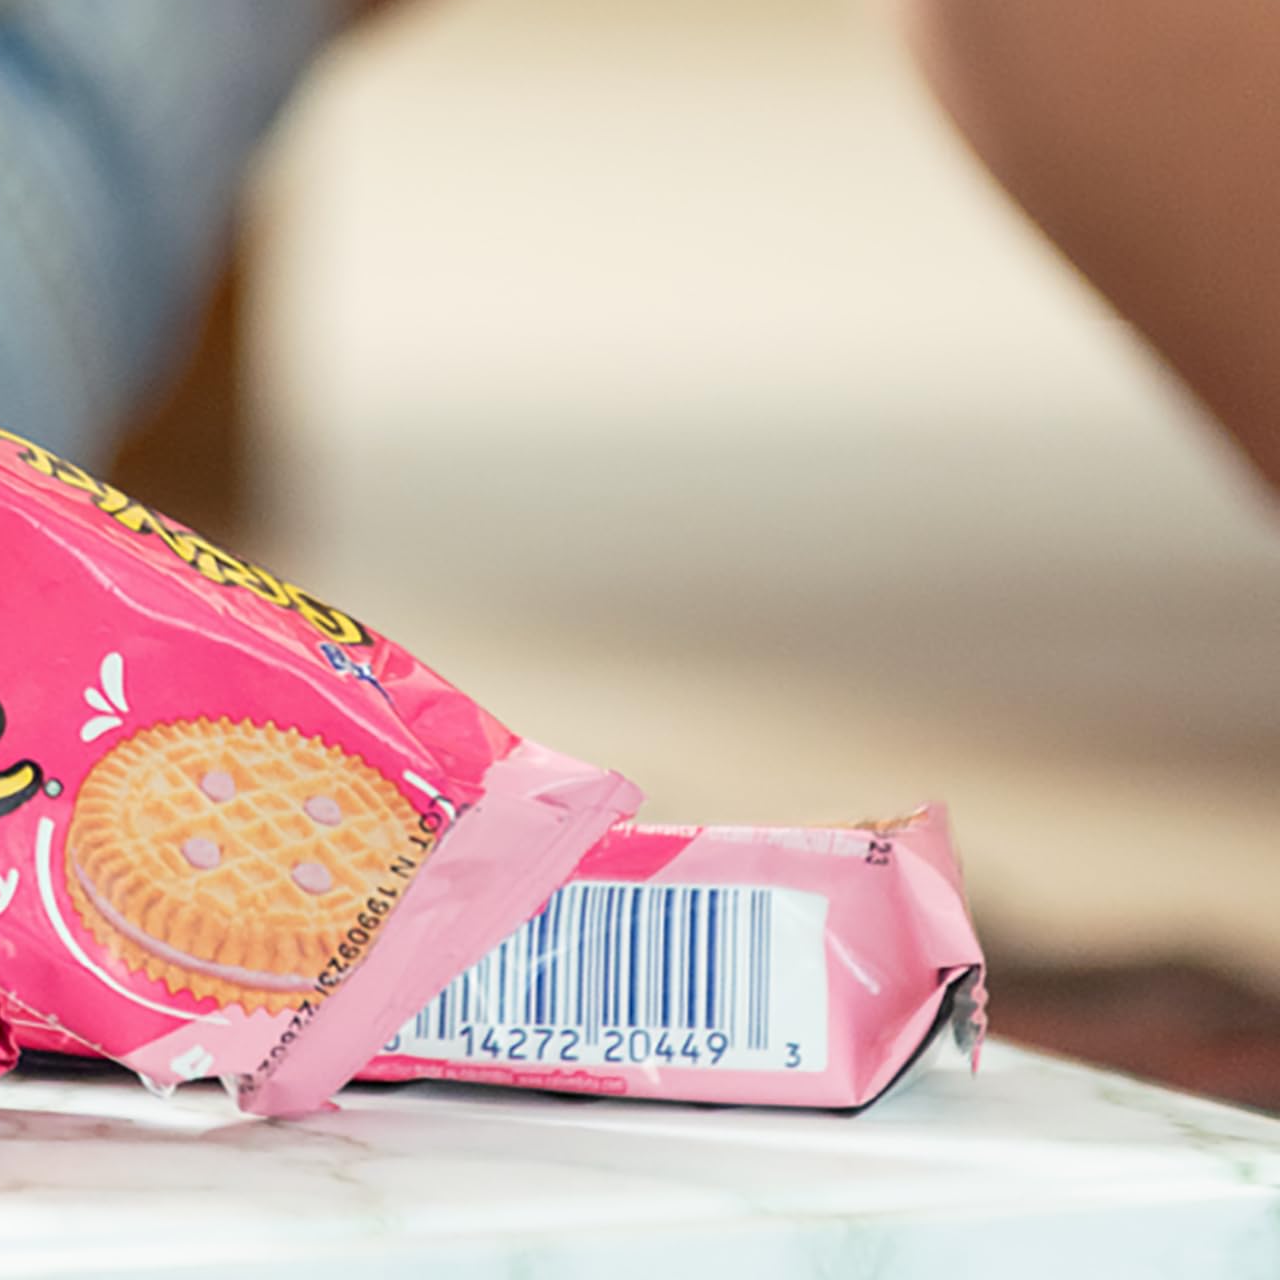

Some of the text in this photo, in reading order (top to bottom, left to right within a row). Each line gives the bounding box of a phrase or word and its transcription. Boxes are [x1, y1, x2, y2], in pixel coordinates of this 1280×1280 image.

[459, 1026, 803, 1069] 14272 20449 3
